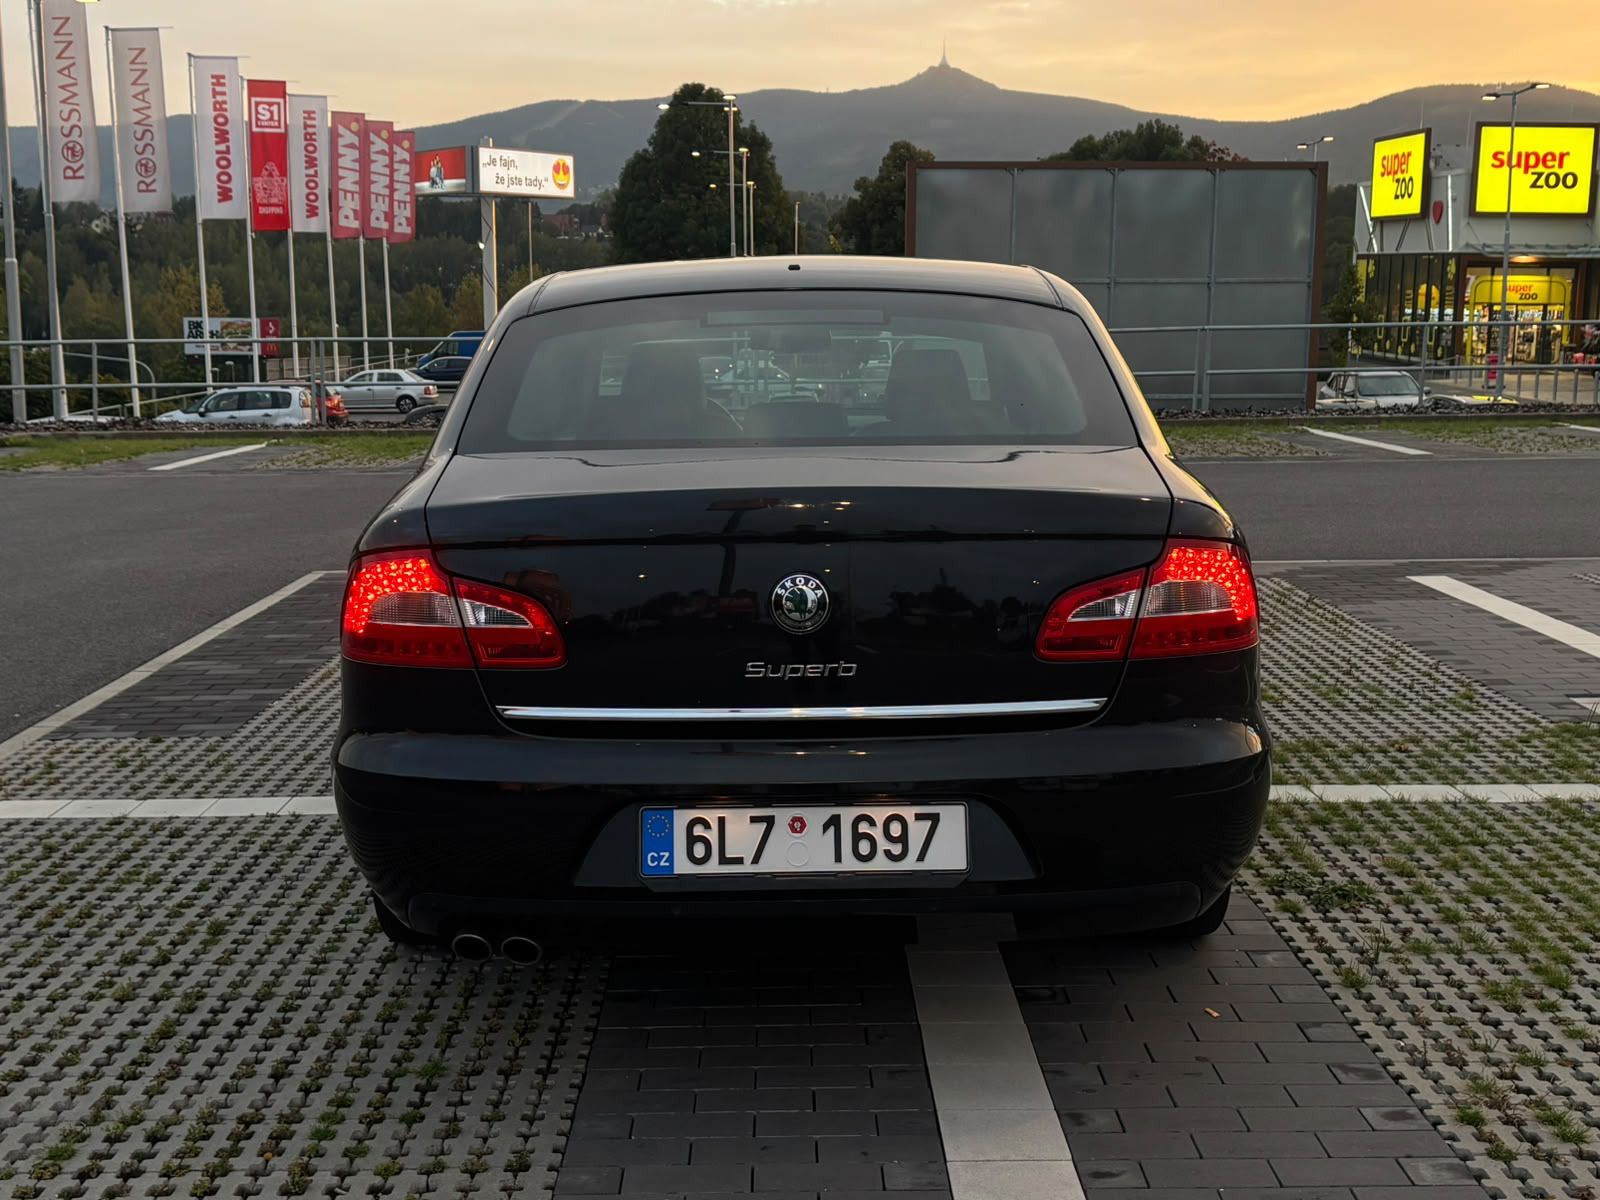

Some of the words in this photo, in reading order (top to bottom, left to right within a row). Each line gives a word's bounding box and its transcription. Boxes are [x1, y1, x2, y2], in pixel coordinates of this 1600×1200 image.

[52, 15, 85, 181] ROSSMANN
[128, 47, 157, 194] ROSSMANN
[257, 104, 279, 121] S1
[210, 74, 233, 204] WOOLWORTH
[305, 109, 319, 219] WOOLWORTH
[499, 156, 518, 171] fajn,
[1380, 151, 1412, 182] super
[1491, 151, 1570, 174] super
[495, 173, 505, 185] že
[506, 174, 523, 188] jste
[1393, 177, 1414, 200] zoo
[1529, 172, 1578, 190] zoo
[1506, 283, 1533, 294] uper
[744, 660, 858, 680] Superb
[685, 813, 776, 866] 6L7
[821, 811, 941, 865] 1697
[647, 851, 670, 867] CZ
